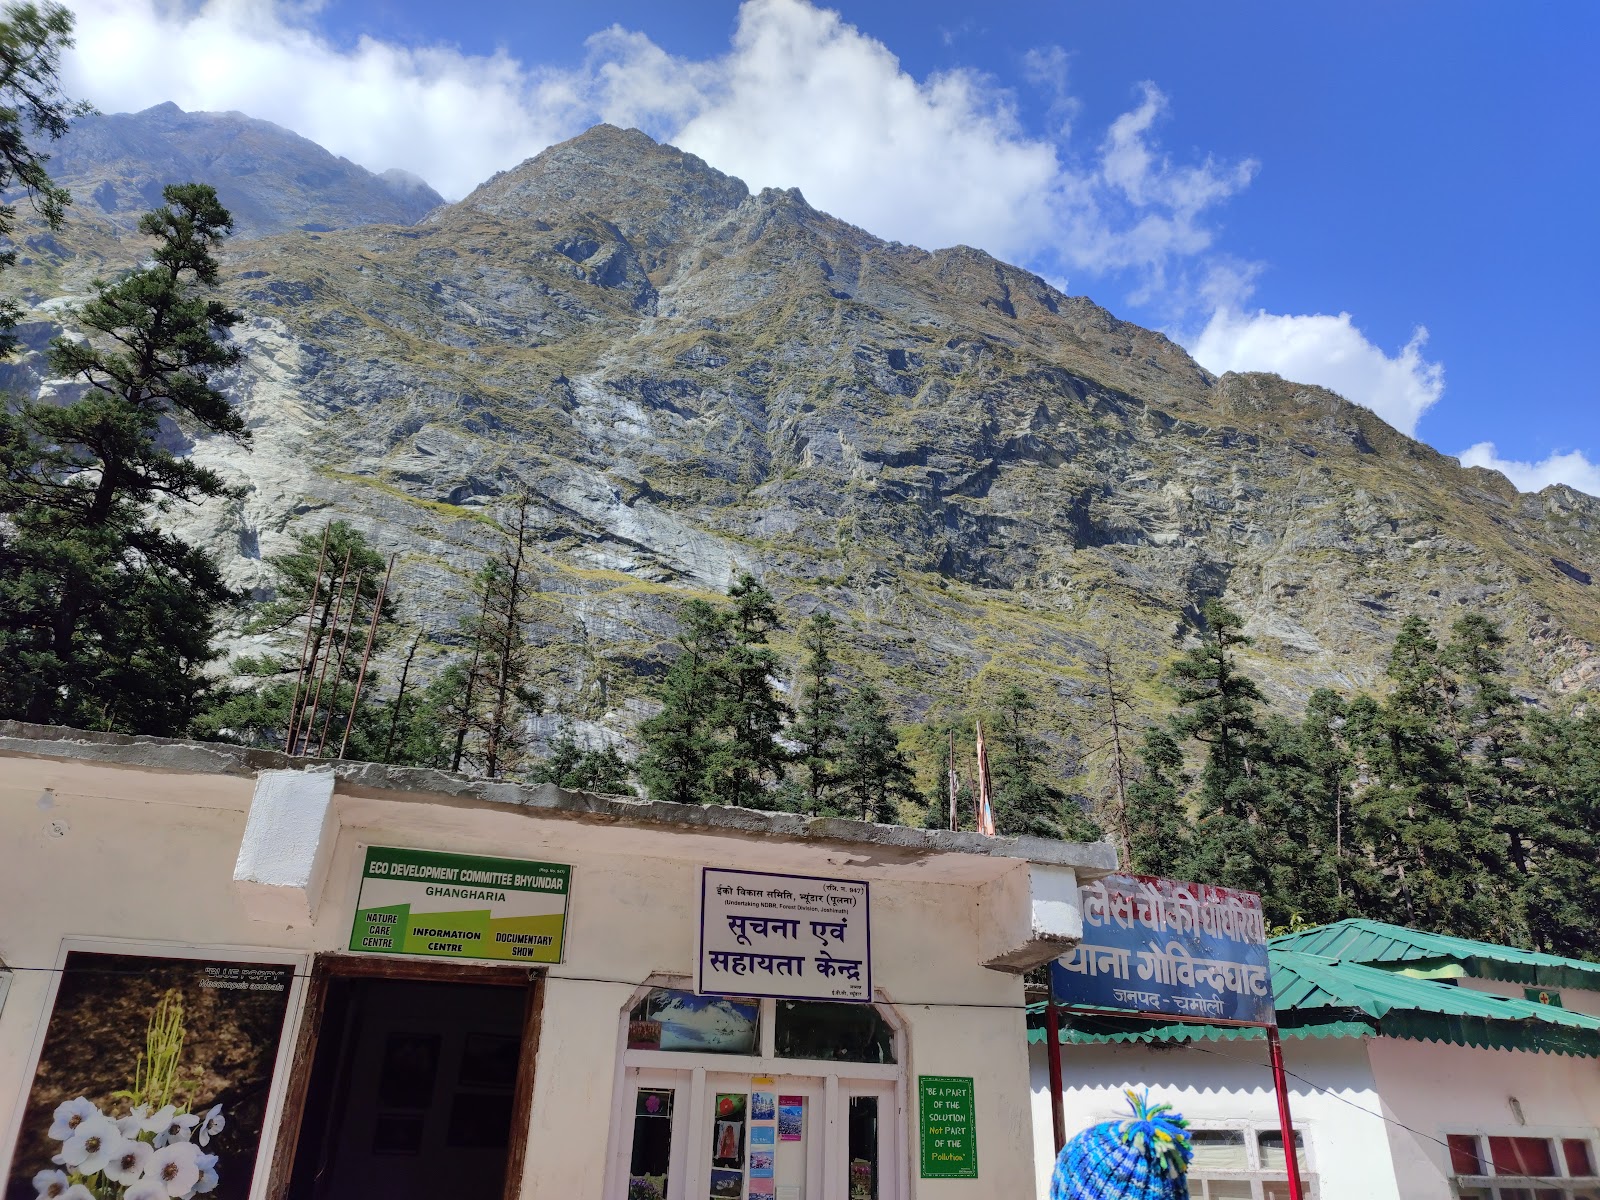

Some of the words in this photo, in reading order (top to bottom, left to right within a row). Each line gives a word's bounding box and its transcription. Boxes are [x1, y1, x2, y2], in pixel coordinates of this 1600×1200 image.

[369, 861, 389, 875] ECO
[390, 865, 459, 882] DEVELOPMENT
[460, 869, 513, 886] COMMITTEE
[514, 874, 564, 890] BHYUNDAR
[425, 886, 506, 902] GHANGHARIA
[716, 883, 734, 896] ईको
[736, 886, 763, 898] विकास
[766, 888, 796, 902] समिति,
[724, 900, 760, 909] (Undertaking
[1136, 881, 1201, 938] चौकी
[366, 913, 398, 924] NATURE
[369, 925, 391, 936] CARE
[413, 927, 481, 940] INFORMATION
[726, 915, 801, 946] सूचना
[809, 917, 848, 947] एवं
[362, 937, 393, 948] CENTRE
[495, 932, 553, 946] DOCUMENTARY
[428, 942, 463, 952] CENTRE
[511, 946, 534, 957] SHOW
[708, 950, 806, 977] सहायता
[815, 950, 863, 981] केन्द्र
[1136, 941, 1268, 997] गोविन्दघाट
[1113, 988, 1161, 1010] जनपद
[1171, 992, 1225, 1015] चमोली
[925, 1087, 938, 1096] "BE
[939, 1088, 945, 1097] A
[945, 1088, 967, 1097] PART
[933, 1100, 943, 1109] OF
[945, 1101, 960, 1109] THE
[929, 1113, 966, 1122] SOLUTION
[929, 1126, 943, 1135] Not
[944, 1126, 966, 1135] PART
[934, 1139, 944, 1148] OF
[946, 1140, 962, 1148] THE
